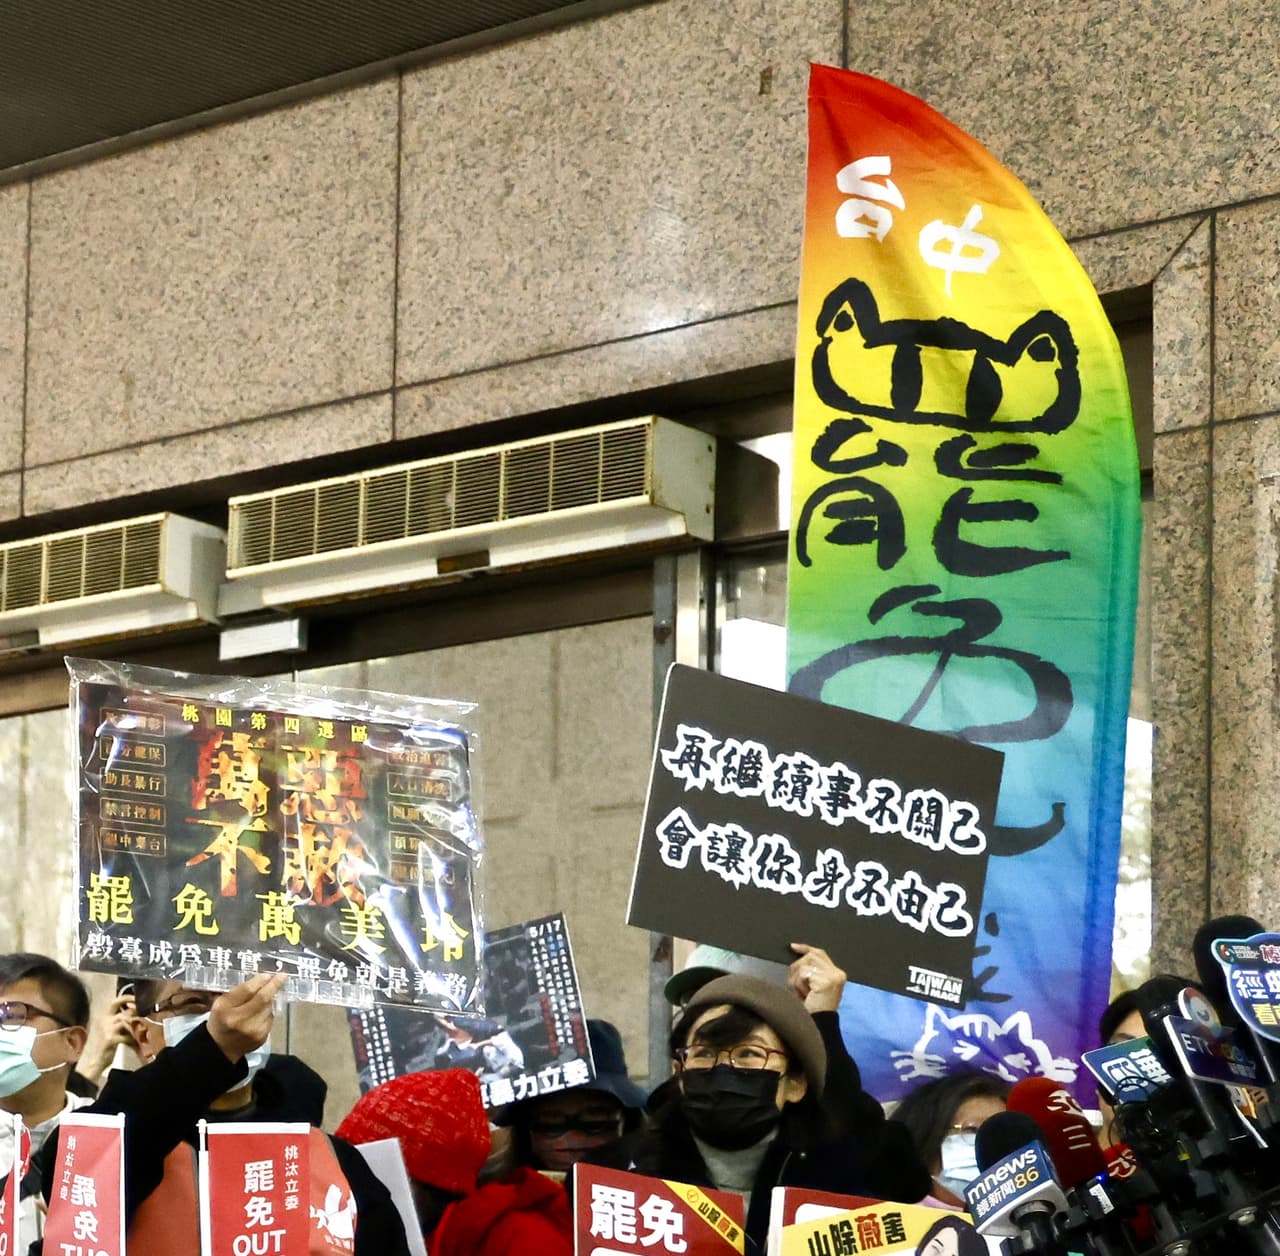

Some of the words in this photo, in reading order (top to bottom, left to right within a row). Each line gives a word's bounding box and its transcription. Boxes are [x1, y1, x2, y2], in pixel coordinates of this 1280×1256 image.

[181, 703, 370, 744] 桃園第四選區
[662, 724, 986, 857] 再繼續事不關己
[655, 805, 974, 937] 會讓你身不由己
[528, 919, 562, 938] 5/17
[243, 1159, 276, 1229] 罷免
[284, 1144, 301, 1212] 桃汰立委
[966, 1149, 1038, 1206] mnews
[1014, 1167, 1040, 1190] 86
[589, 1182, 689, 1255] 罷免
